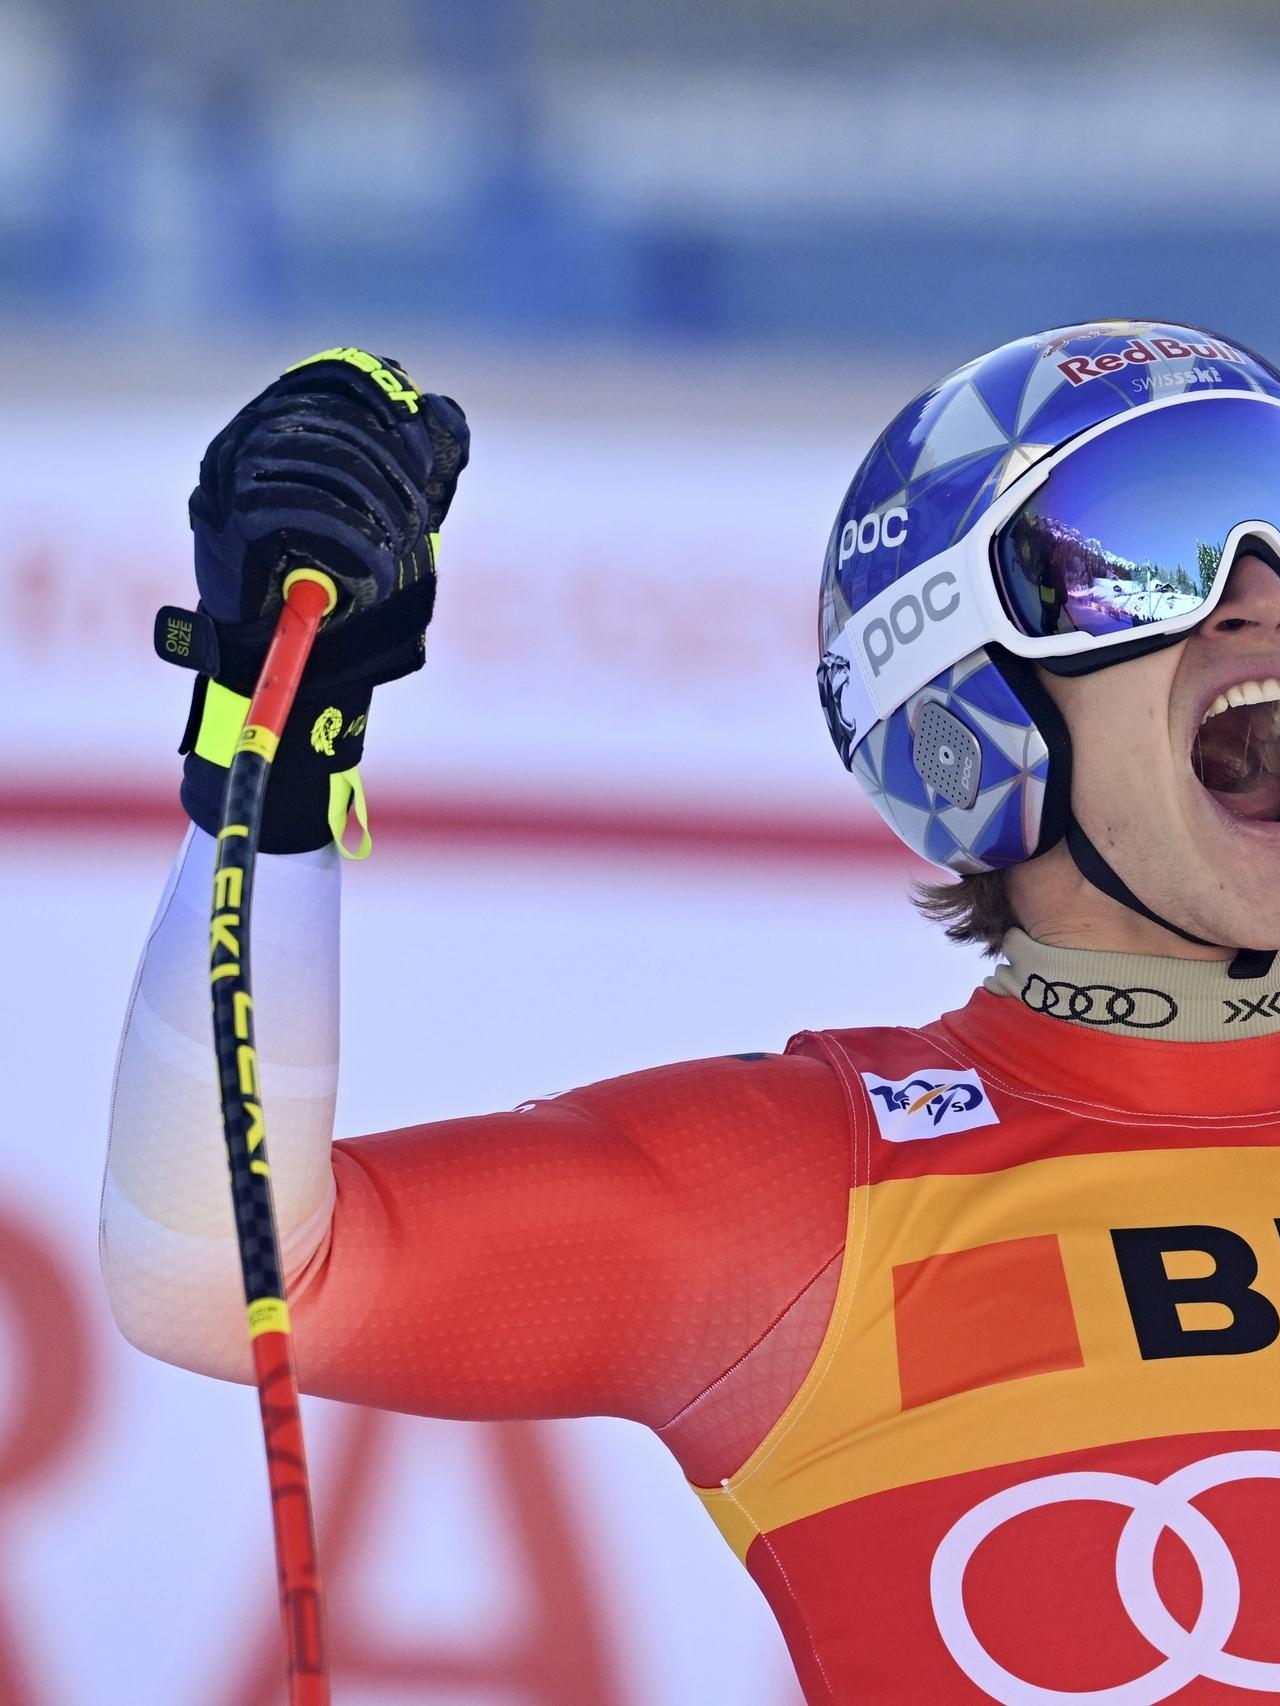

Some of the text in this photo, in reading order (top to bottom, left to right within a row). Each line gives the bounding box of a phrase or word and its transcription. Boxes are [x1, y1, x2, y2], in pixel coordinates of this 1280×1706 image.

[1057, 337, 1246, 388] Red Bull
[166, 617, 180, 653] ONE
[177, 620, 193, 657] SIZE
[210, 824, 249, 984] LEKI
